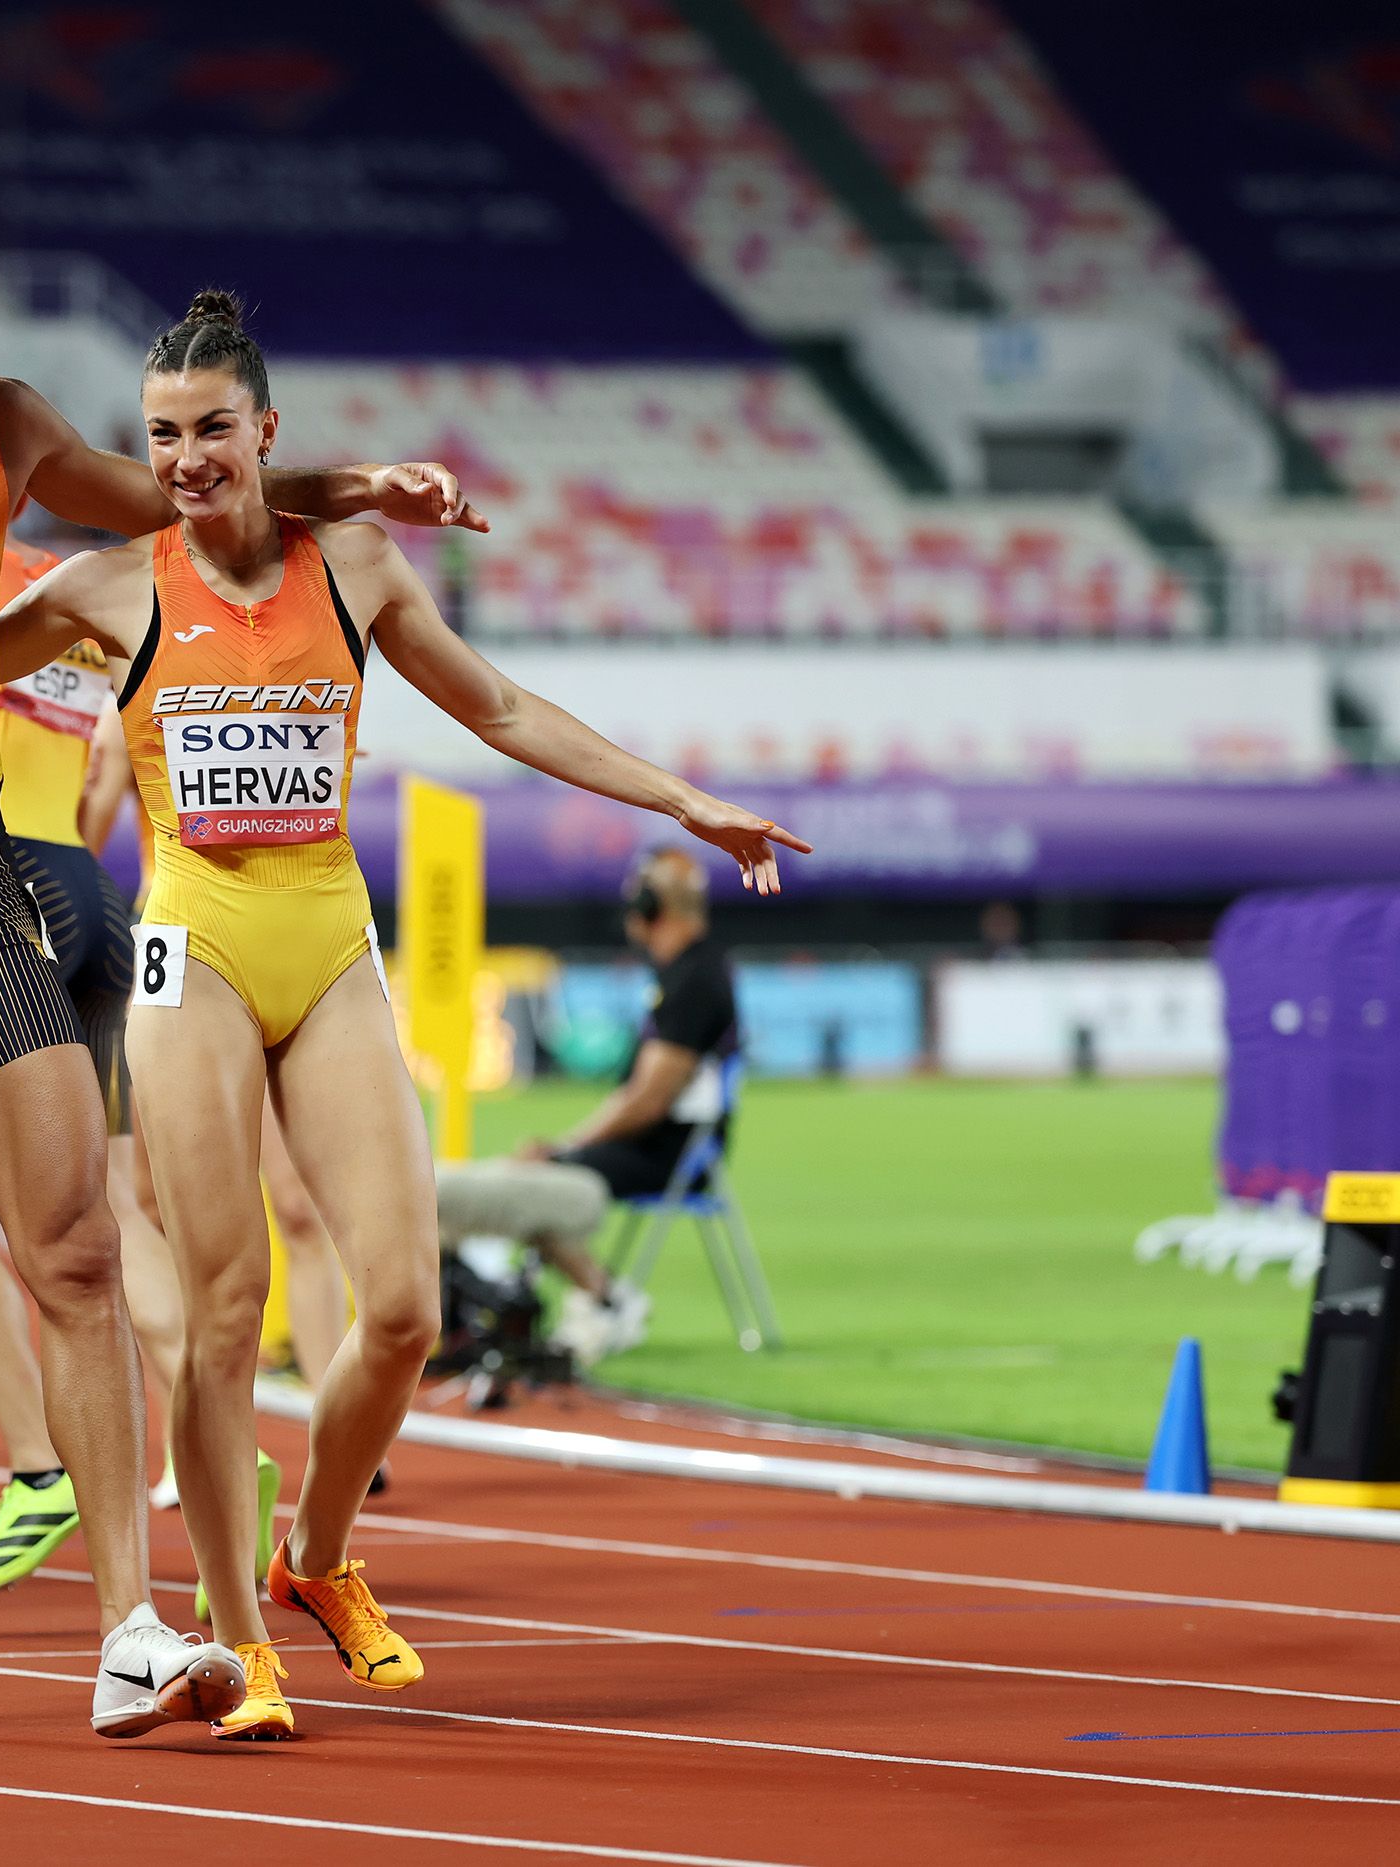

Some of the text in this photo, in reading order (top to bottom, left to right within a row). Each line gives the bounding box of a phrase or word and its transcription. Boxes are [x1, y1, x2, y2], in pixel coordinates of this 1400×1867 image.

[34, 666, 80, 700] ESP
[151, 678, 355, 714] ESPAÑA
[181, 723, 330, 752] SONY
[179, 766, 334, 808] HERVAS
[216, 817, 337, 834] GUANGZHOU 25
[144, 937, 167, 994] 8
